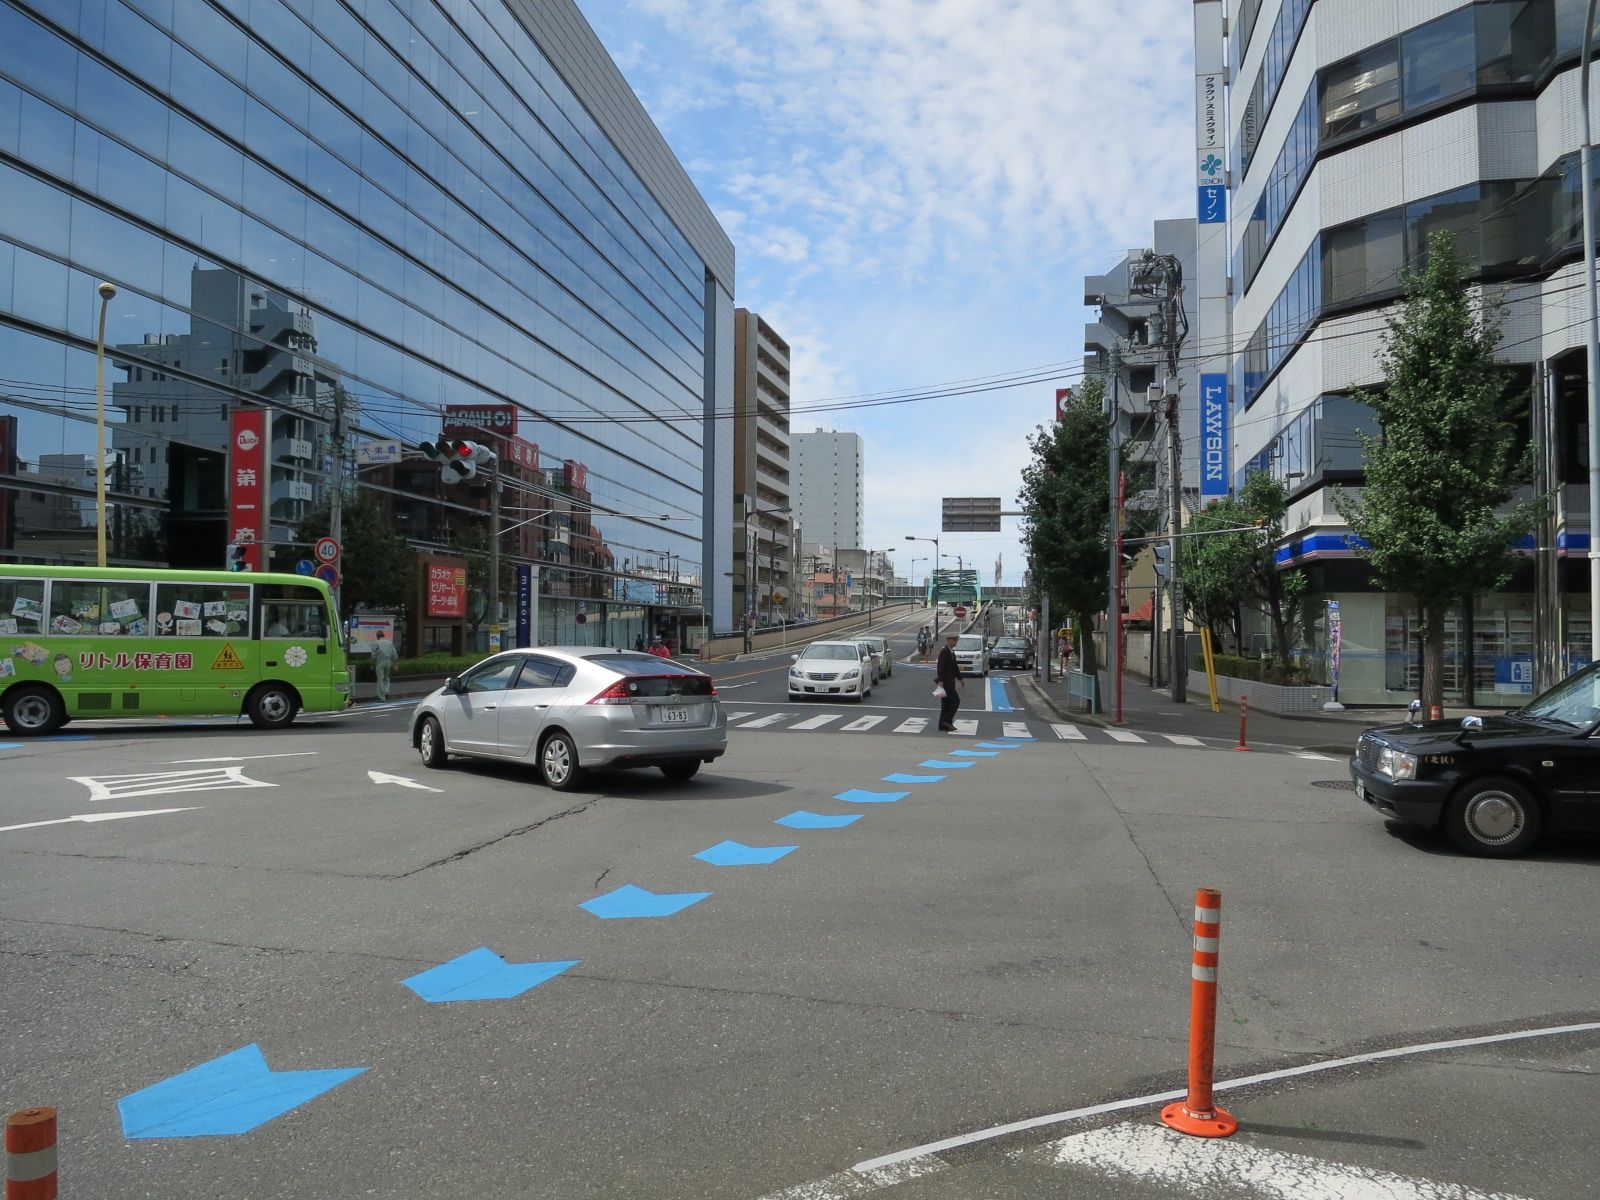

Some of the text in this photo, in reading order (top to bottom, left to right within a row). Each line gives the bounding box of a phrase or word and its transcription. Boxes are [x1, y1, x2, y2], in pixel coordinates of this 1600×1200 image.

[1200, 178, 1223, 186] SENON
[1206, 188, 1218, 220] セノン
[1206, 386, 1222, 480] LAWSON
[321, 545, 335, 556] 40
[431, 568, 452, 580] カラオケ
[431, 581, 457, 594] ビリヤード
[79, 652, 193, 671] リトル保育園
